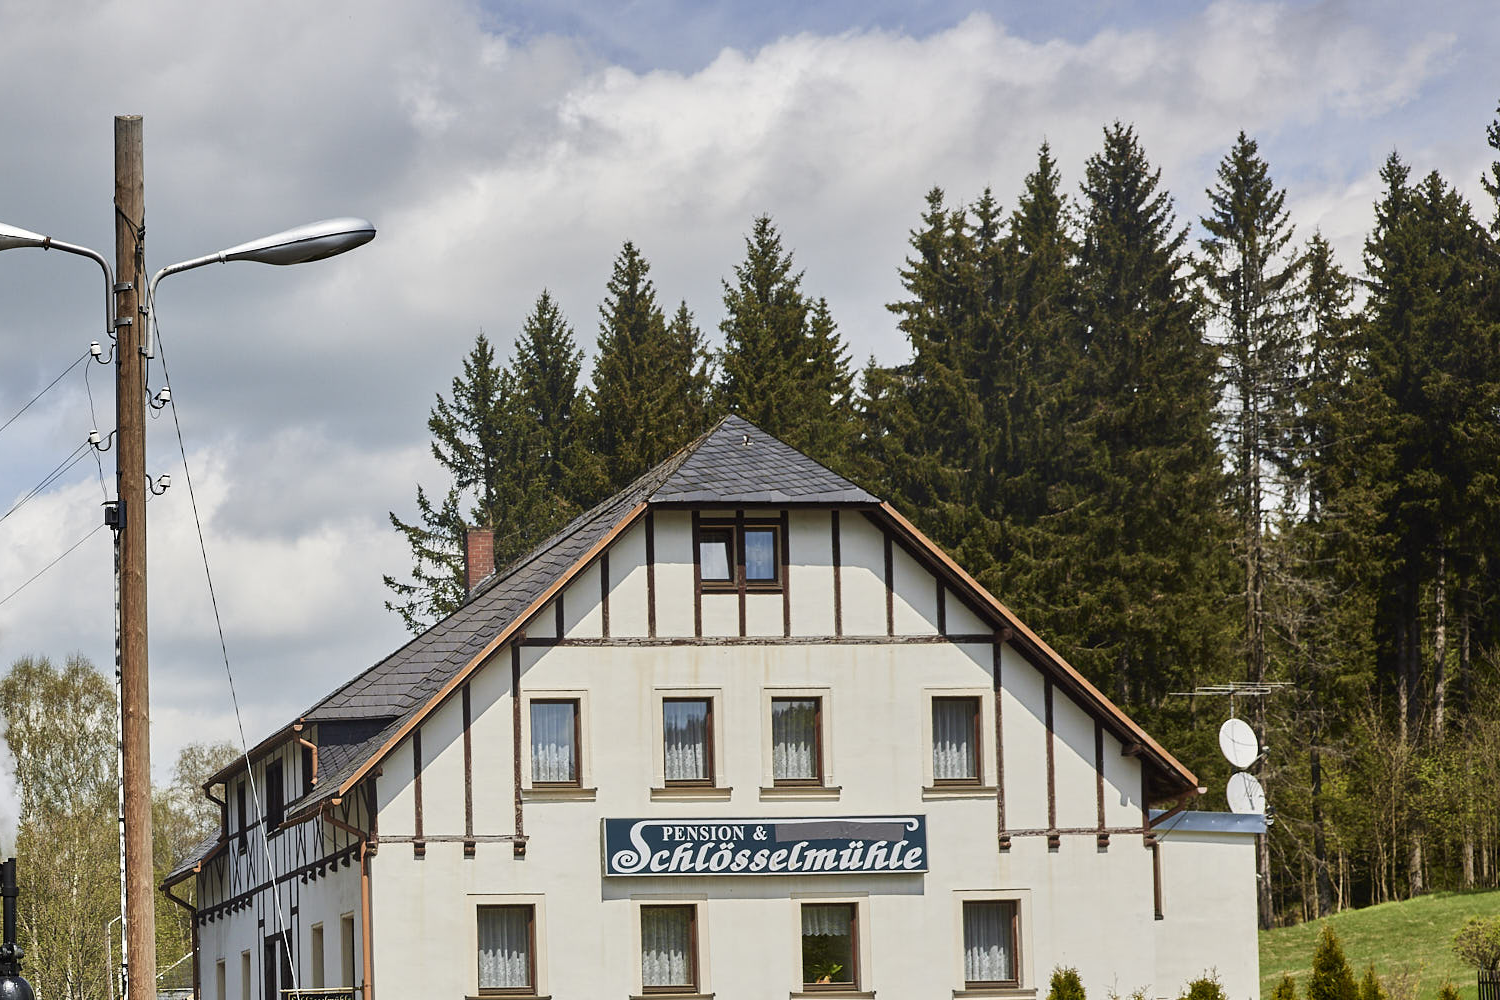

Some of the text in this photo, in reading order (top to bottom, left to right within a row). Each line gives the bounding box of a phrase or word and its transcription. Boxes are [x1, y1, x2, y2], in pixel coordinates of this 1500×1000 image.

[611, 818, 924, 875] Schlösselmühle
[662, 825, 768, 842] PENSION &
